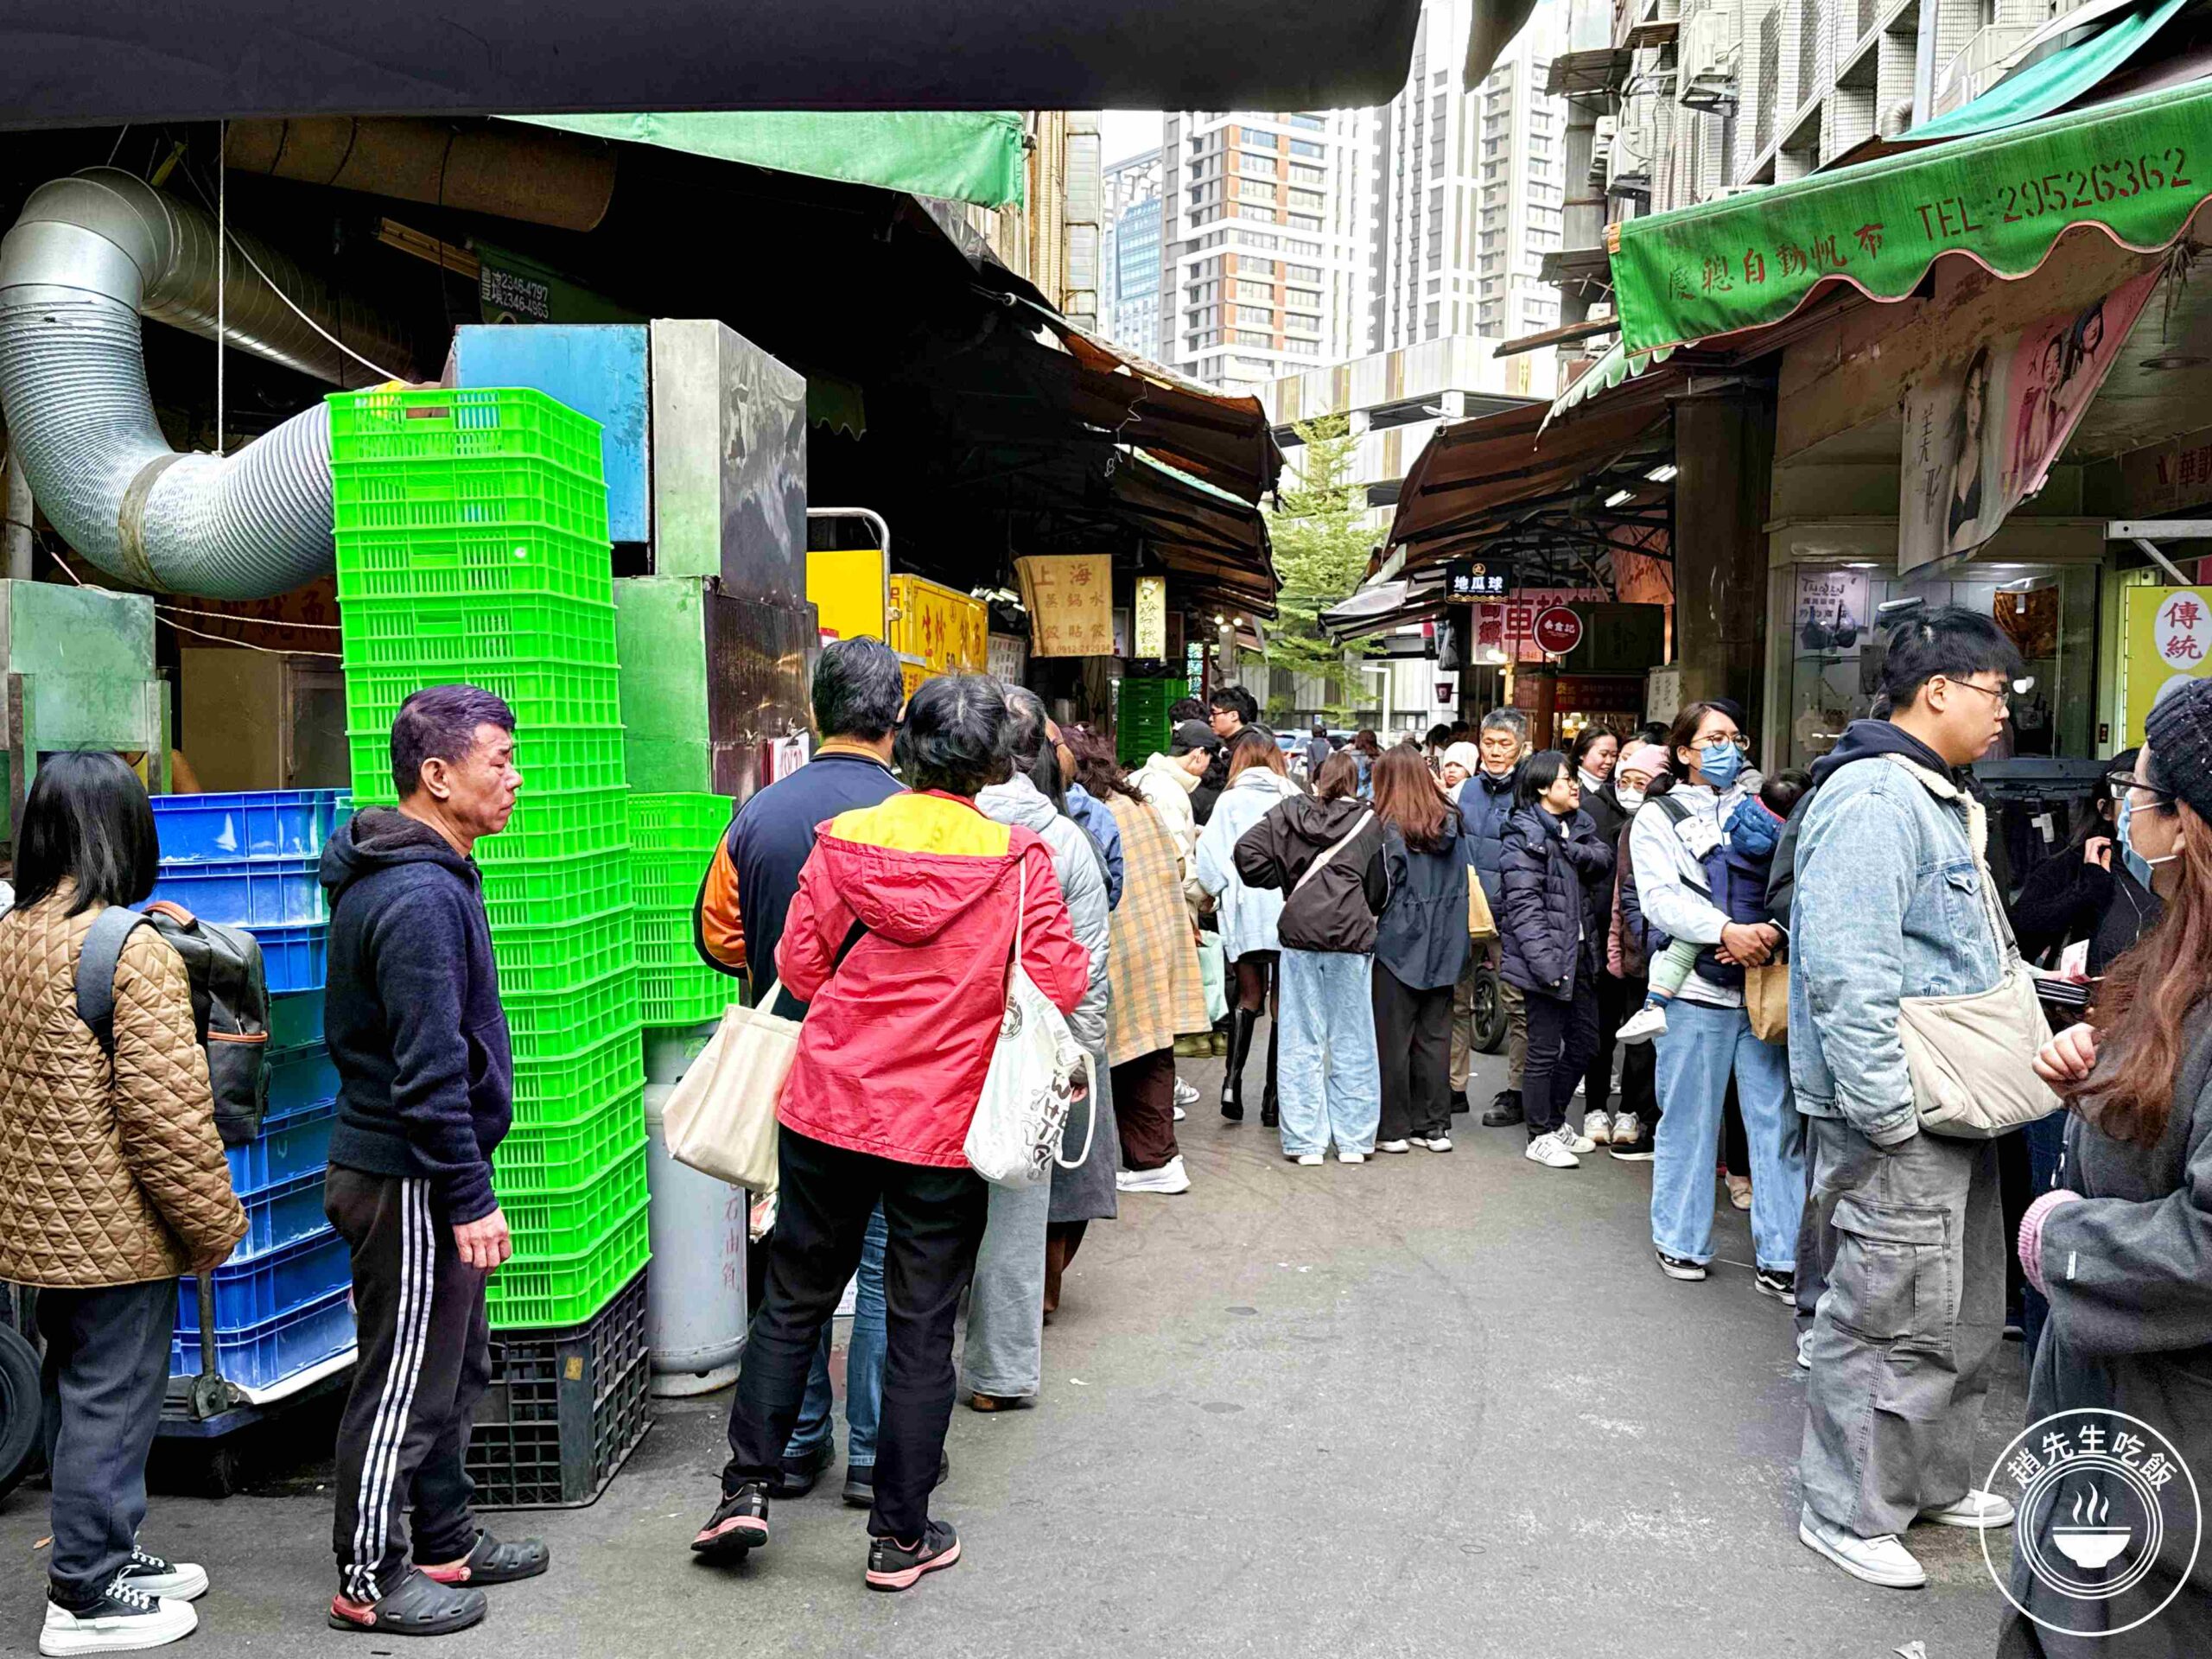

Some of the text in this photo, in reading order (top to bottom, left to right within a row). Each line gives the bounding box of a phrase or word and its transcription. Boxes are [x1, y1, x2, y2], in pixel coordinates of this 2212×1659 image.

[1033, 563, 1093, 587] 上海
[1453, 575, 1503, 591] 地瓜球
[2164, 600, 2203, 661] 傳統
